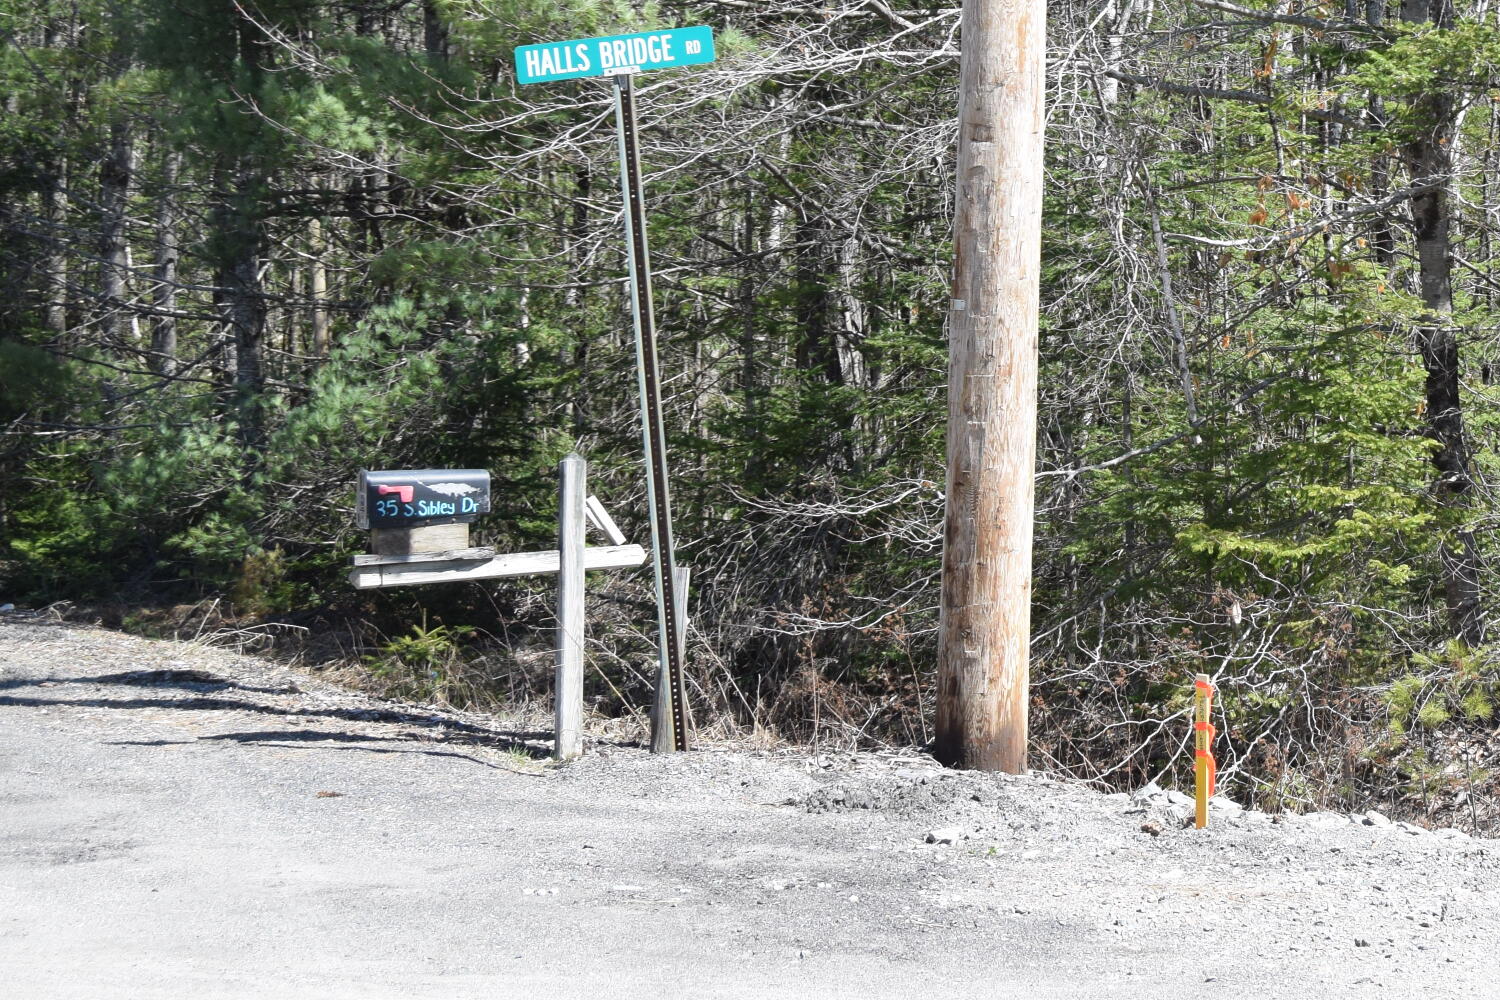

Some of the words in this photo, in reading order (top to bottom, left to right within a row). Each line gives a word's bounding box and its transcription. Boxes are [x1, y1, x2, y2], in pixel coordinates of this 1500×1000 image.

[525, 43, 591, 77] HALLS
[598, 34, 675, 69] BRIDGE
[685, 40, 701, 55] RD
[376, 500, 399, 517] 35
[418, 499, 455, 517] Sibley
[461, 497, 480, 513] Dr
